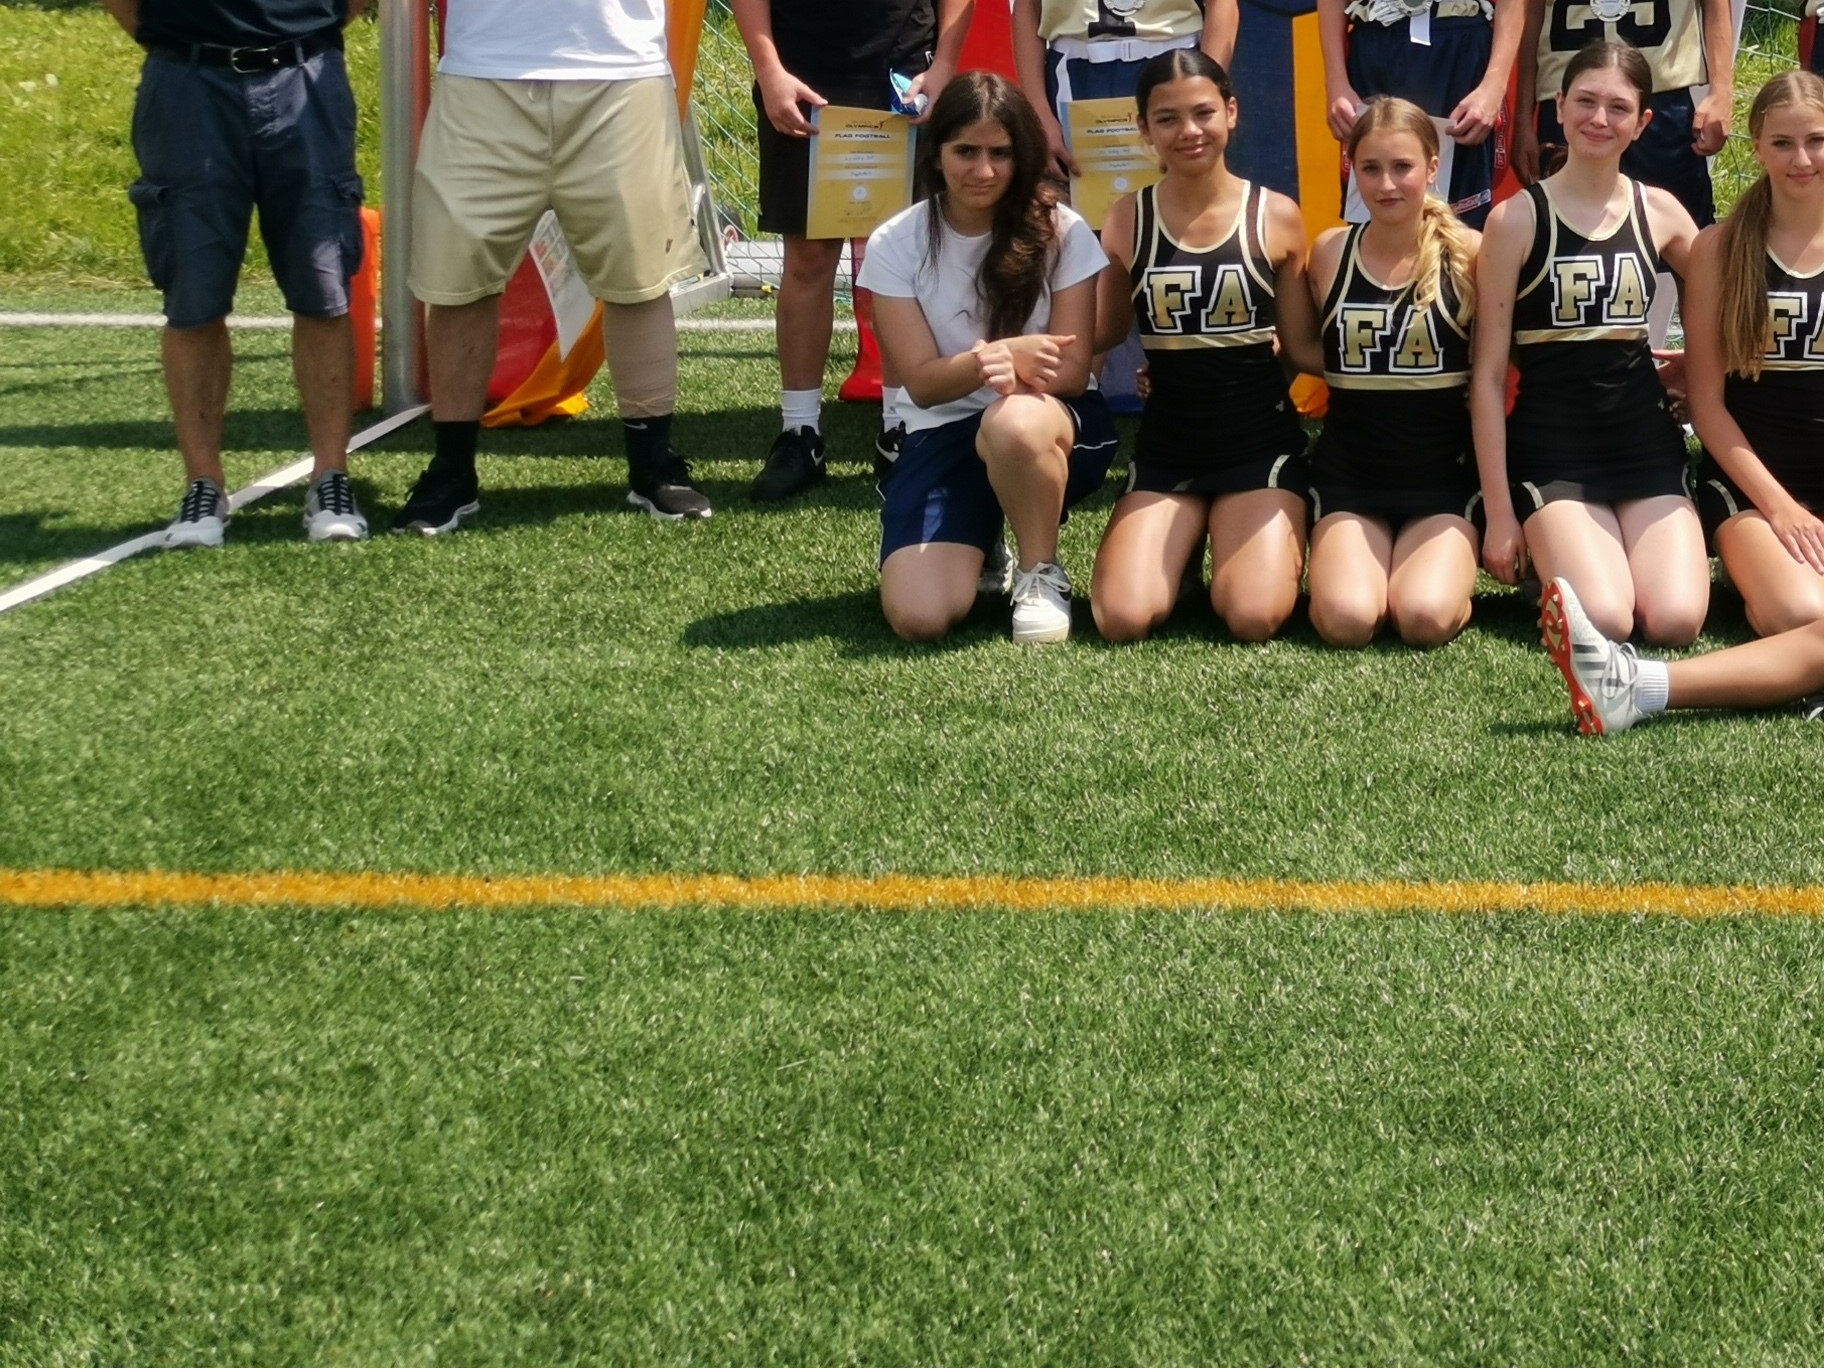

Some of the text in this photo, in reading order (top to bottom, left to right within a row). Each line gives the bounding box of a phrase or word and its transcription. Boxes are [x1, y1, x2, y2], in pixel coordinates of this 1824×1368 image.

[1145, 264, 1258, 333] FA
[1550, 252, 1649, 326] FA
[1336, 303, 1444, 372] FA
